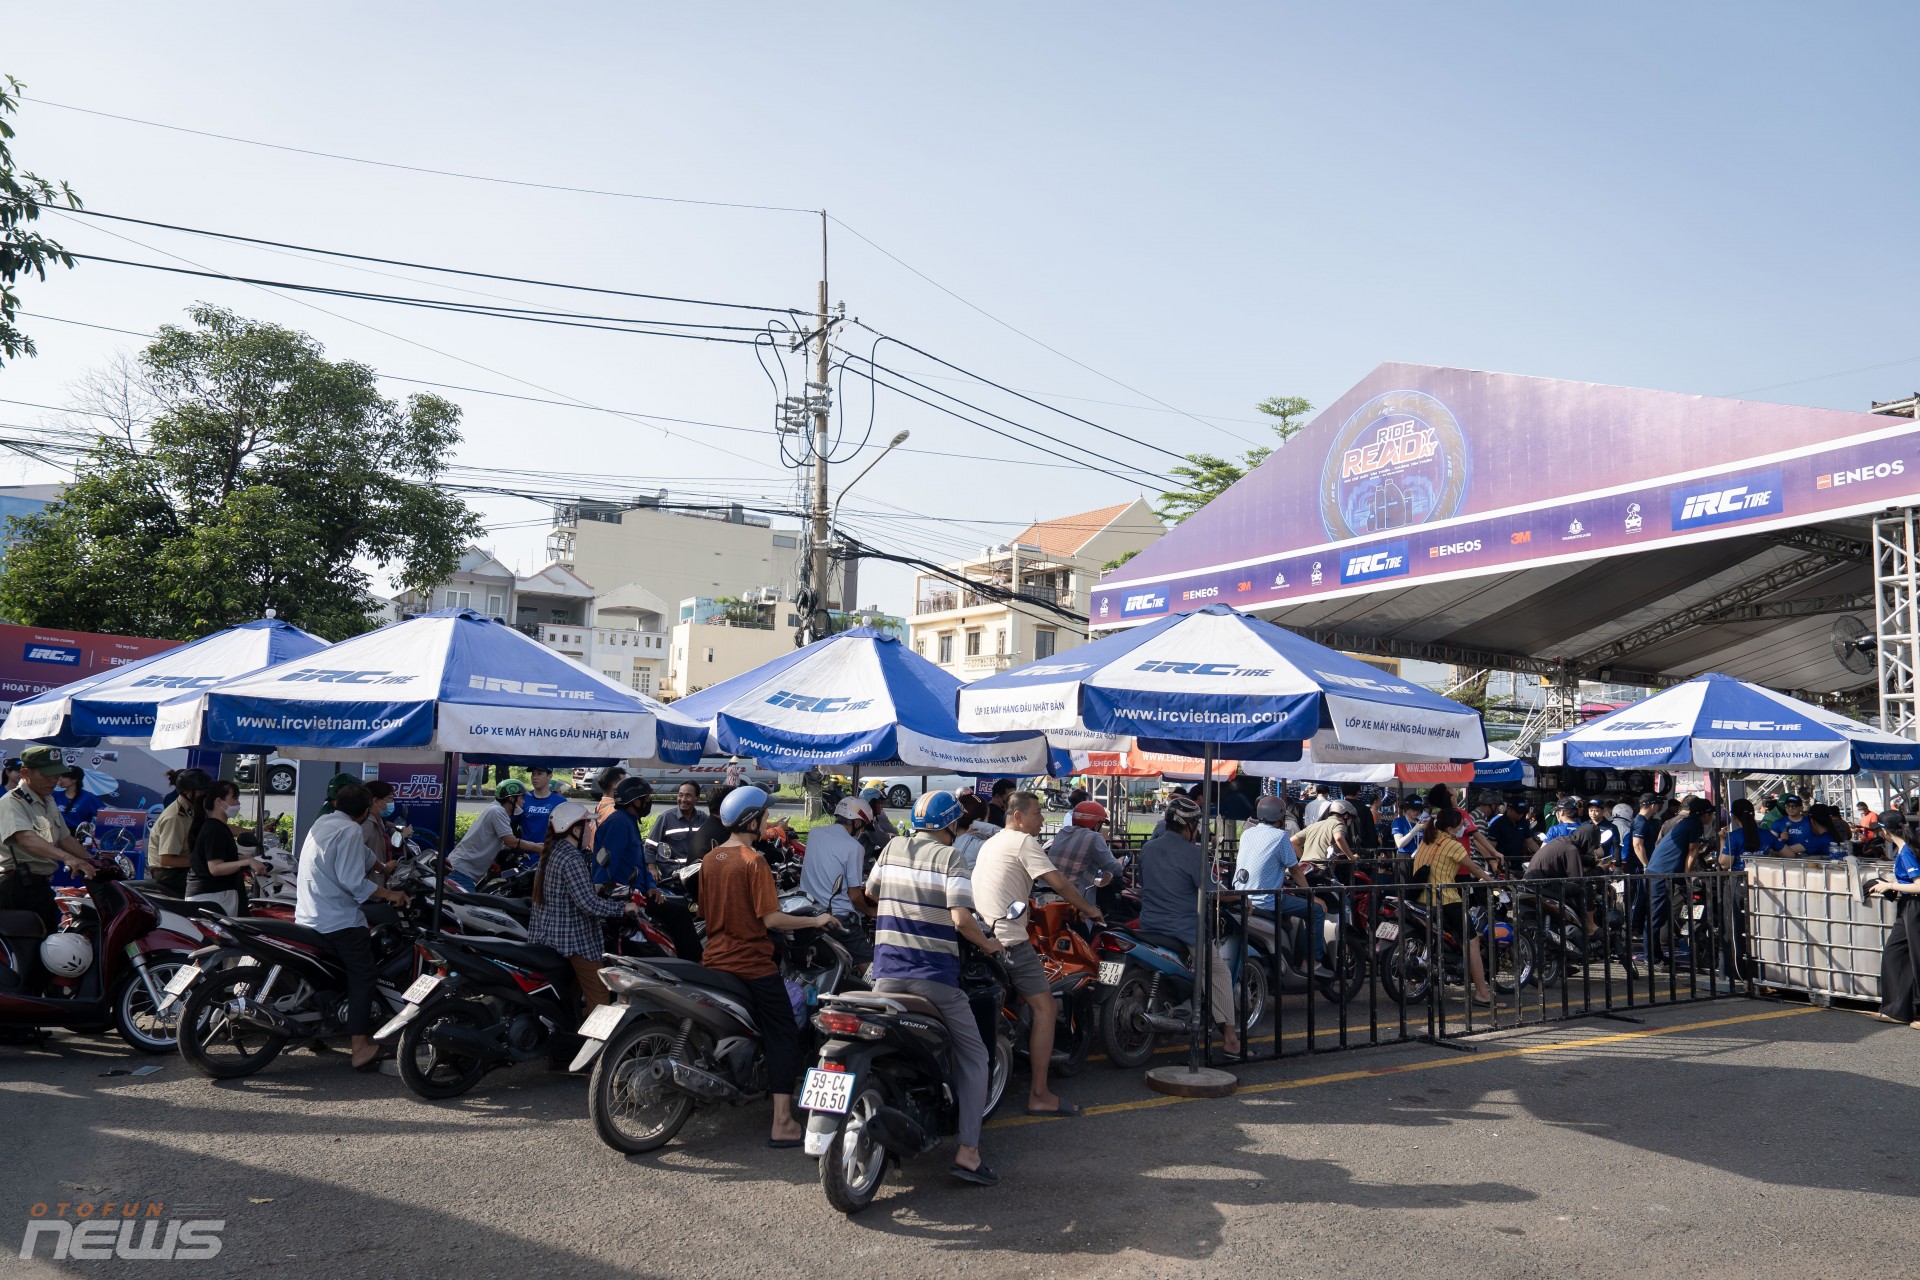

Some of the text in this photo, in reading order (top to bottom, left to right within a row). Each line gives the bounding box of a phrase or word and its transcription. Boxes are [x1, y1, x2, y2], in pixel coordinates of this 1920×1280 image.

[1377, 420, 1414, 443] RIDE
[1834, 459, 1905, 487] ENEOS
[1681, 486, 1772, 520] IRC TIRE
[1511, 531, 1531, 544] 3M
[1439, 539, 1482, 557] ENEOS
[1345, 552, 1402, 576] IRC TIRE
[1189, 586, 1219, 600] ENEOS
[1238, 581, 1251, 592] 3M
[278, 668, 393, 684] IRC
[1134, 660, 1275, 677] IRC TIRE
[468, 674, 595, 700] IRC TIRE
[765, 690, 875, 713] IRC TIRE
[236, 715, 404, 730] www.ircvietnam.com
[1113, 707, 1288, 724] www.ircvietnam.com
[1345, 716, 1361, 728] LỐP
[1362, 719, 1372, 730] XE
[1373, 719, 1389, 731] MÁY
[469, 725, 489, 736] LỐP
[490, 726, 504, 736] XE
[505, 725, 527, 737] MÁY
[528, 726, 558, 738] HÀNG
[610, 729, 630, 740] BẢN
[1711, 719, 1802, 731] IRC TIRE
[739, 736, 872, 759] www.ircvietnam.com
[1583, 746, 1672, 758] www.ircvietnam.com
[411, 774, 437, 784] RIDE
[811, 1072, 845, 1092] 59-C4
[803, 1089, 846, 1110] 216.50
